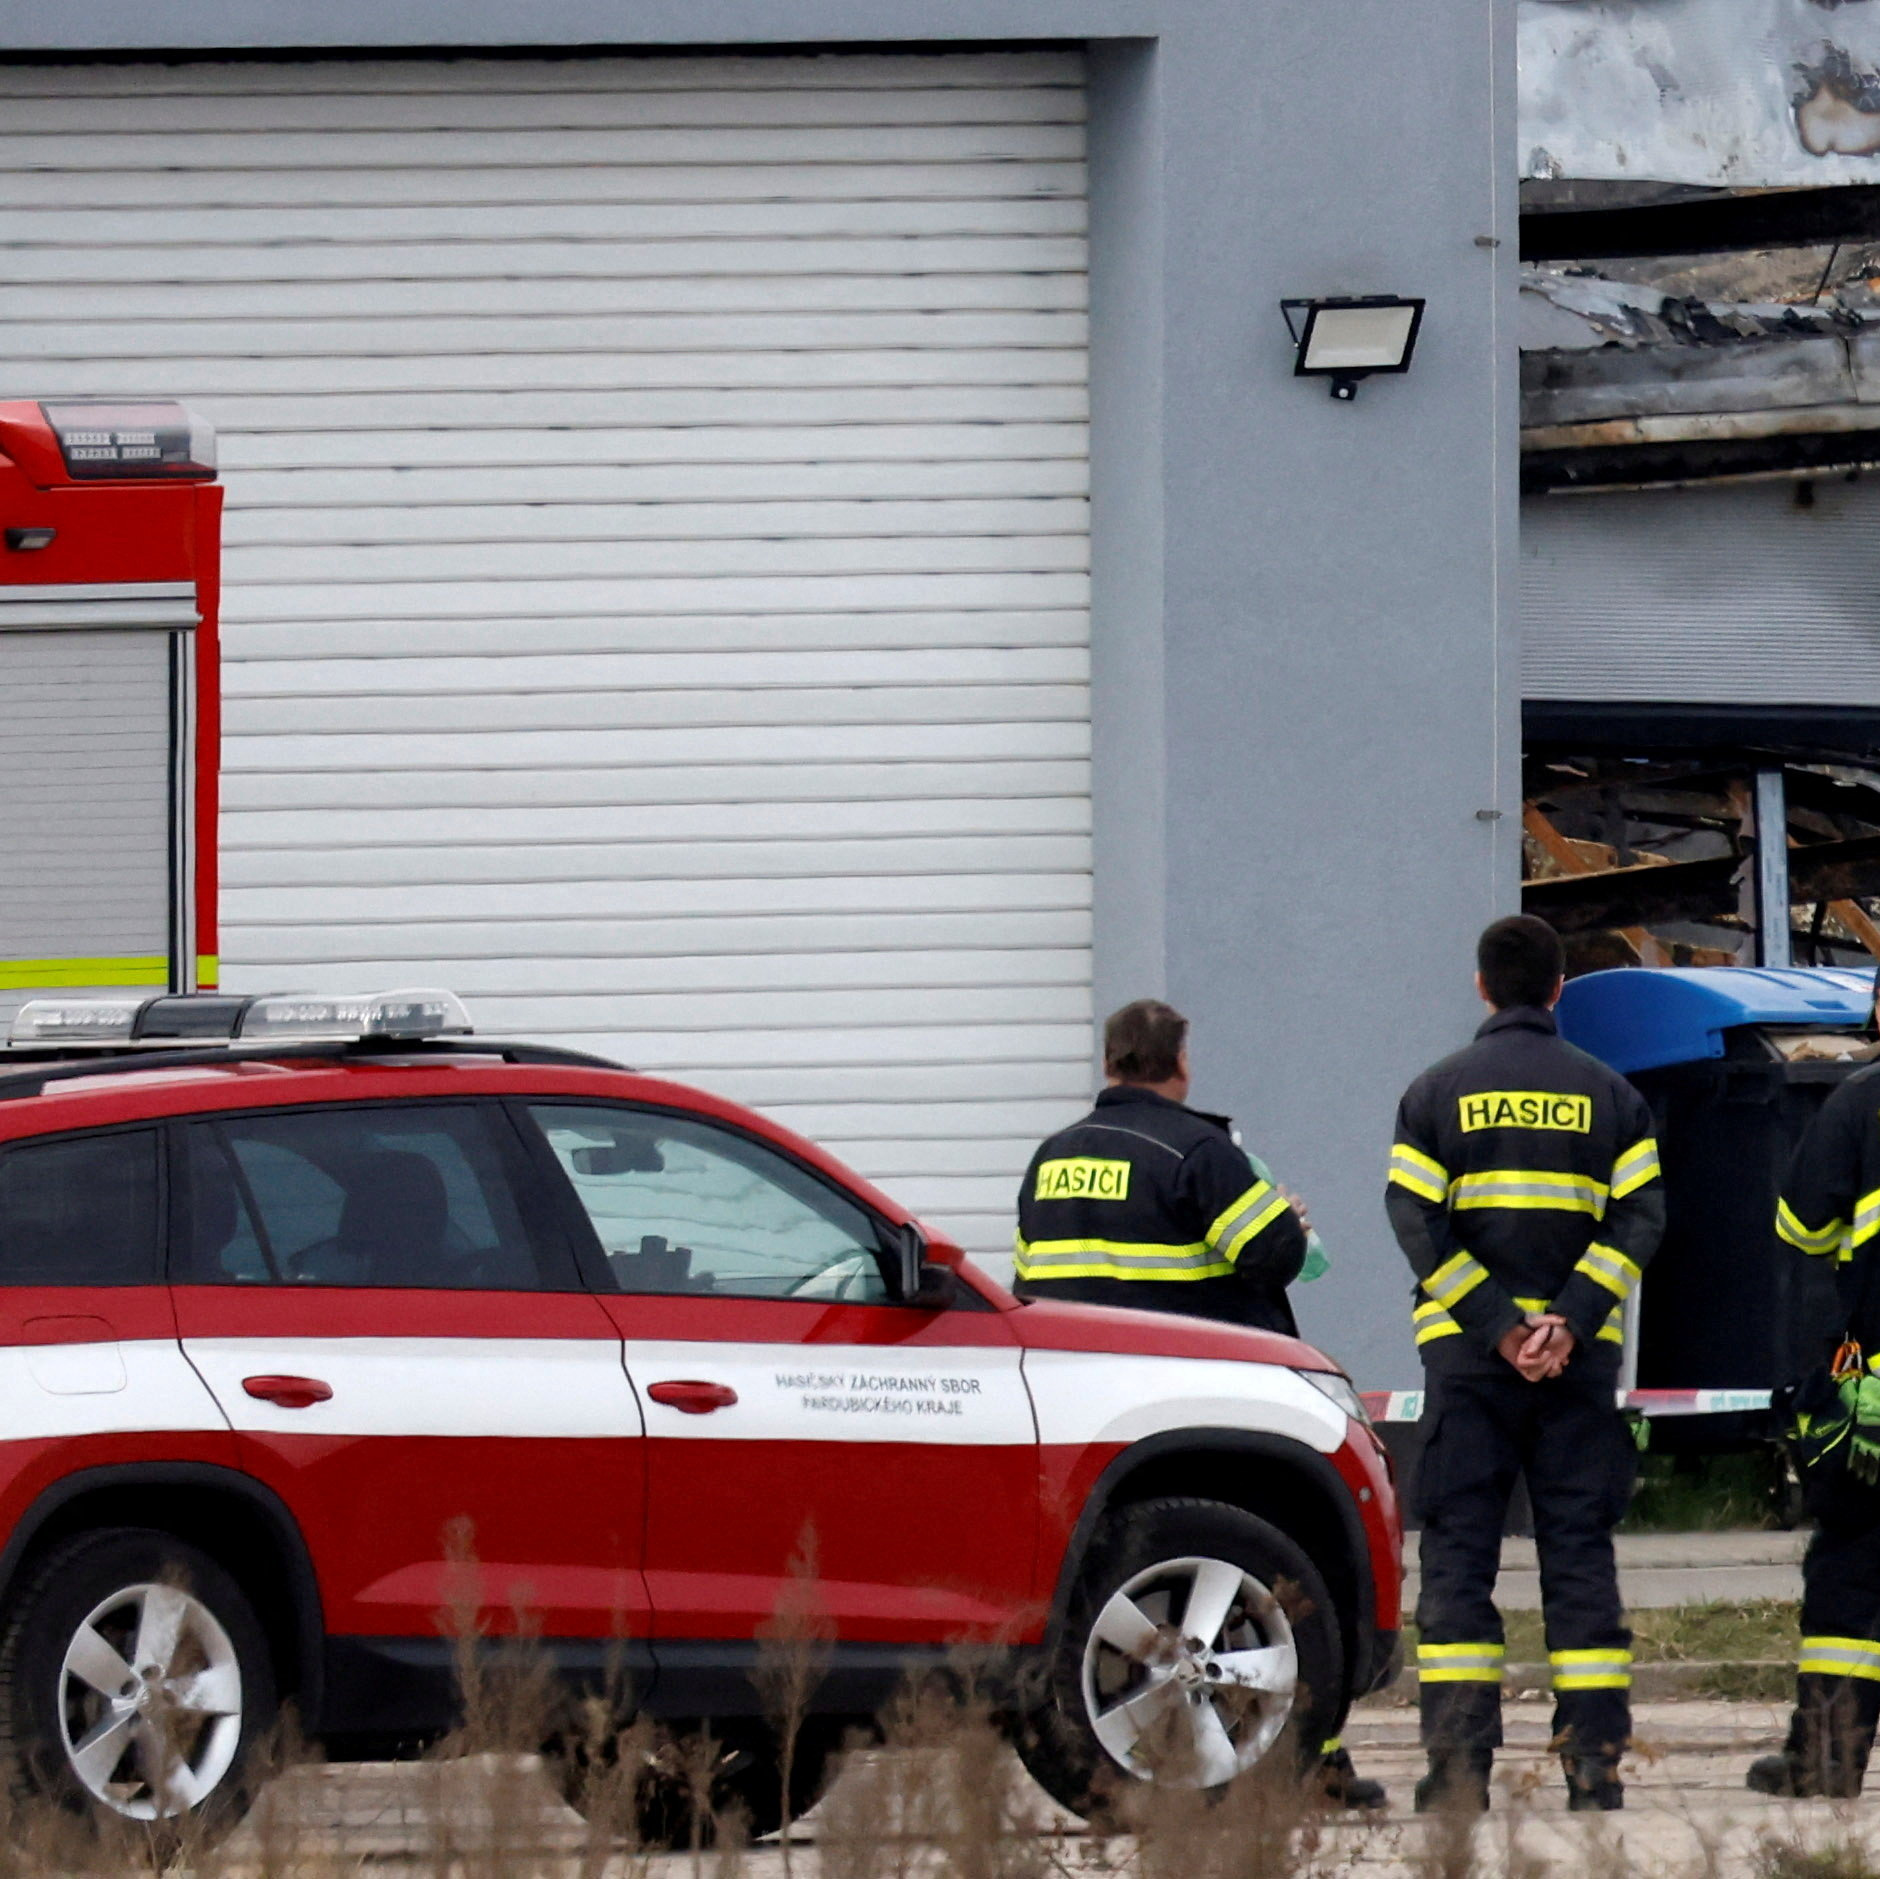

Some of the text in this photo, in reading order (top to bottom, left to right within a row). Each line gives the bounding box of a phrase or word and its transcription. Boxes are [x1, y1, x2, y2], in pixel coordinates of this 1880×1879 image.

[1467, 1097, 1584, 1129] HASIČI
[1040, 1165, 1122, 1196] HASIČI
[940, 1378, 982, 1394] SBOR
[916, 1400, 963, 1415] KRAJE
